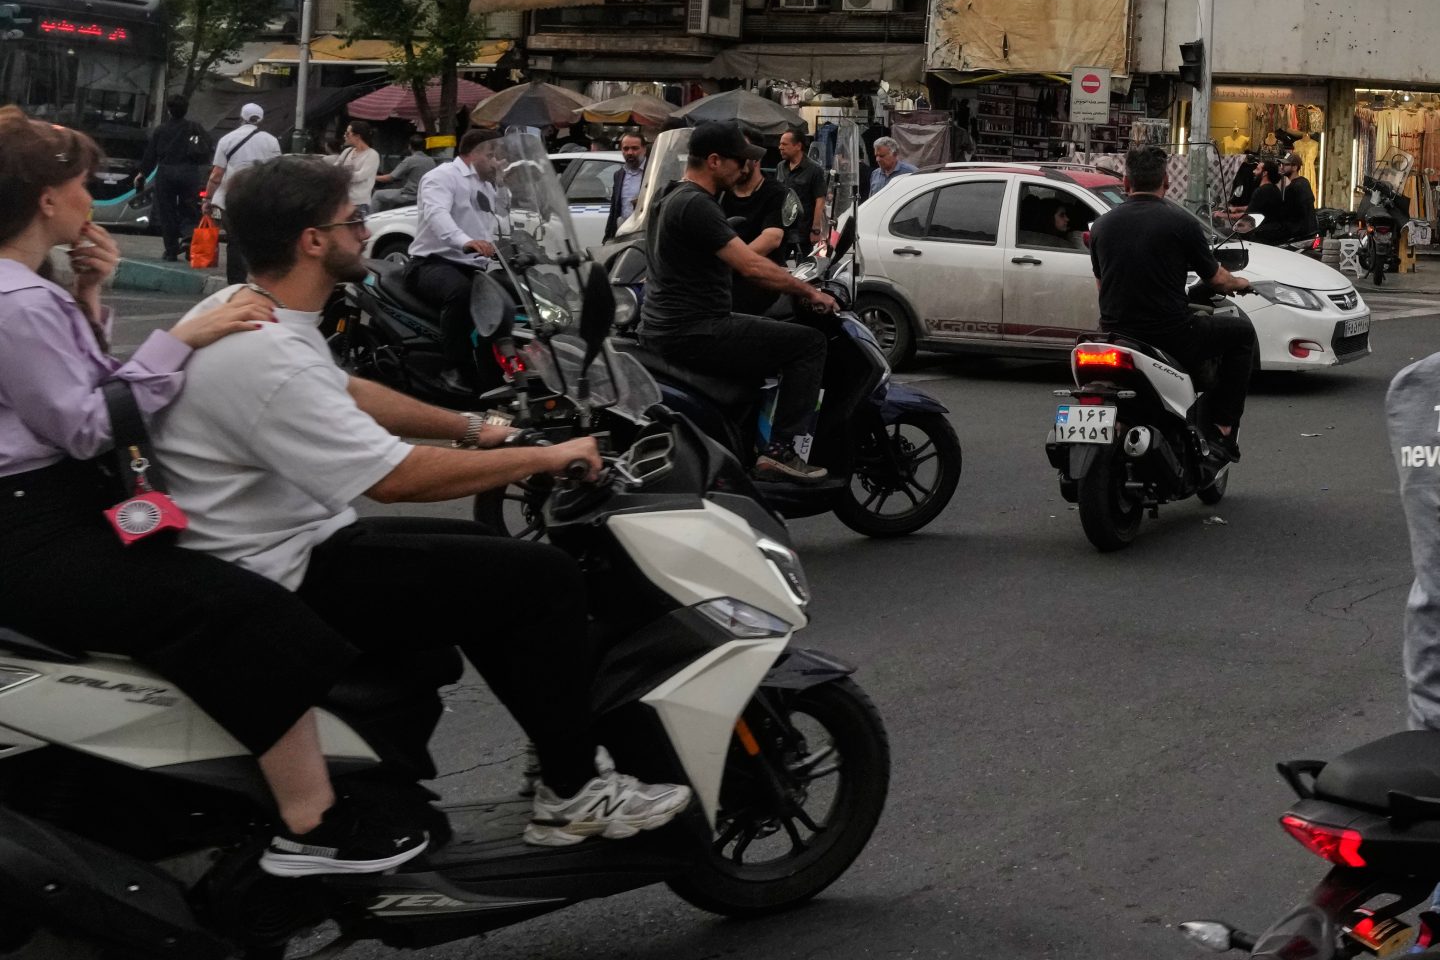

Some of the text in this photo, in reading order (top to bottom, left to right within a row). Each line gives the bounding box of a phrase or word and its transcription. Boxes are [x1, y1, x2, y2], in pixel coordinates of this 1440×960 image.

[940, 320, 1000, 334] CROSS
[1078, 408, 1107, 423] ۱۶۴
[1059, 425, 1109, 441] ۱۶۹۵۹
